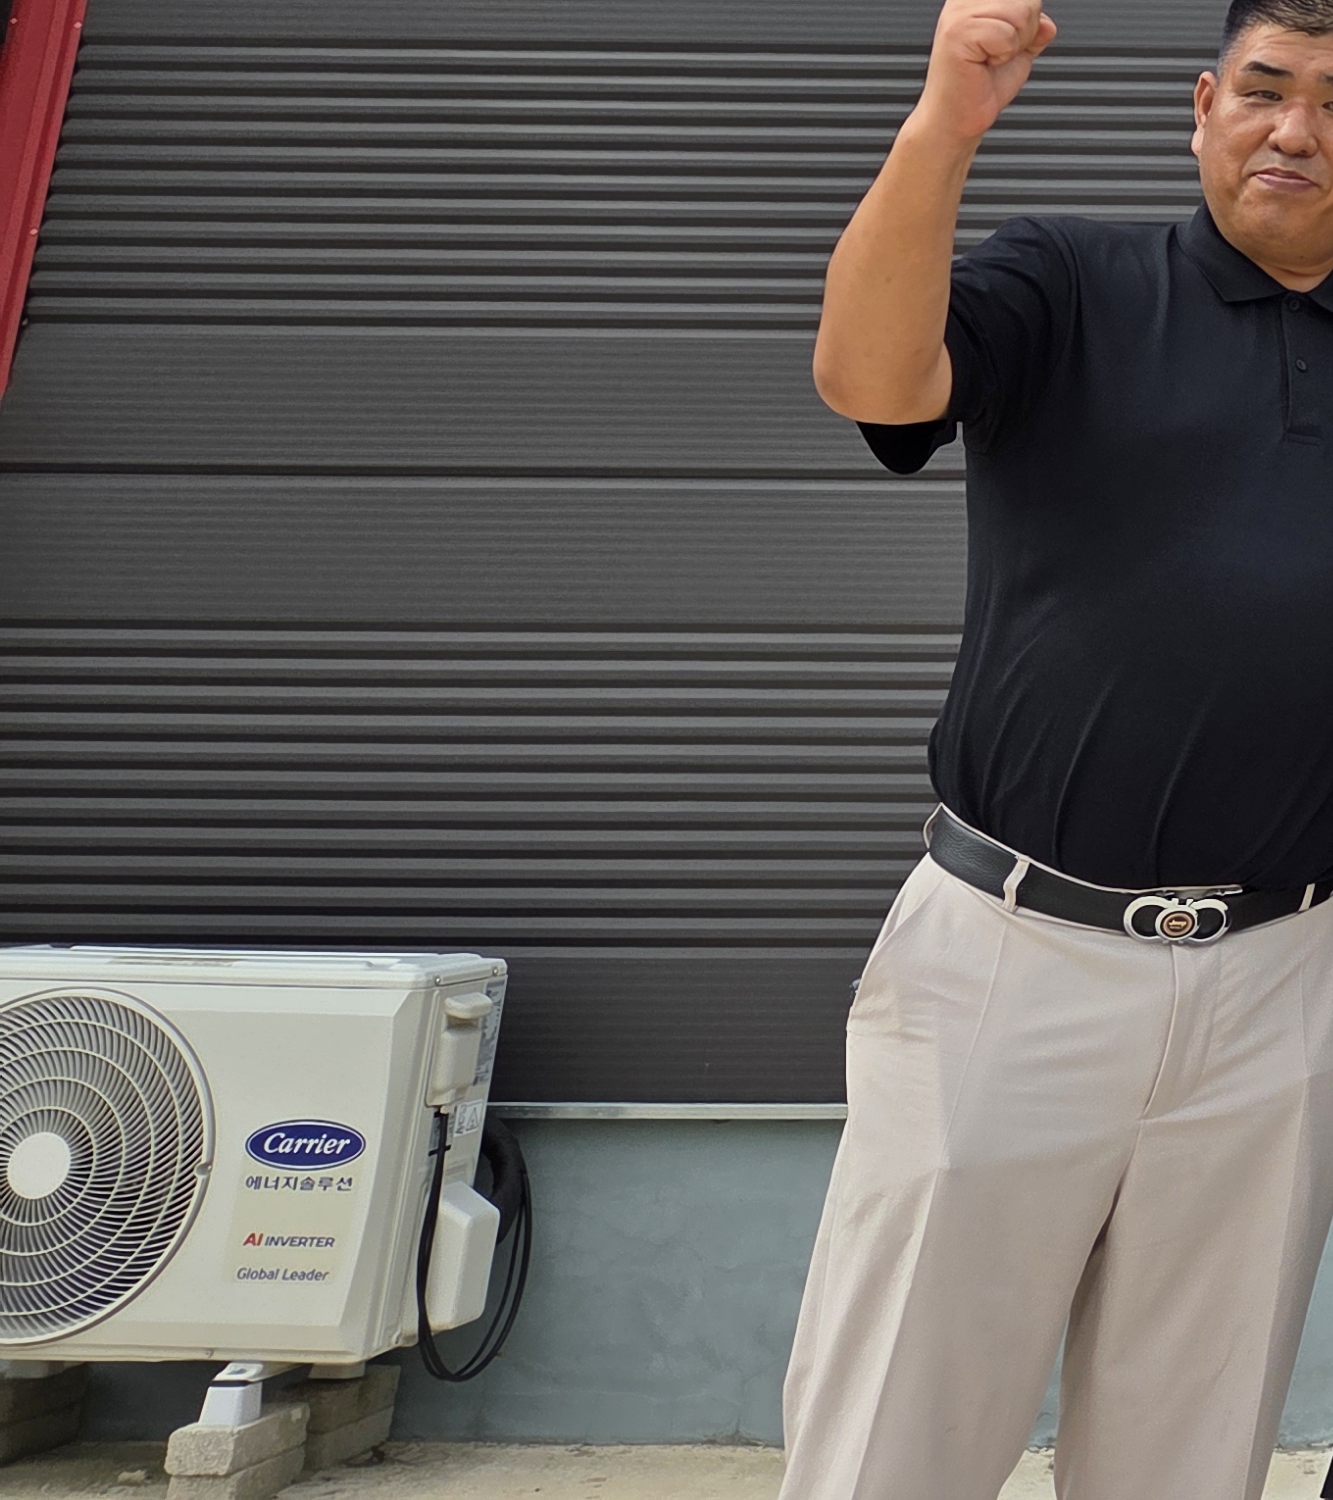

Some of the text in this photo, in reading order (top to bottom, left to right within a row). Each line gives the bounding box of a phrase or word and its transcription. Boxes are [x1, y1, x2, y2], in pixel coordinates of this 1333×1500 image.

[263, 1132, 351, 1155] Carrier
[245, 1175, 353, 1191] 에너지솔루션
[242, 1232, 336, 1248] AI INVERTER
[236, 1267, 330, 1281] Global Leader
